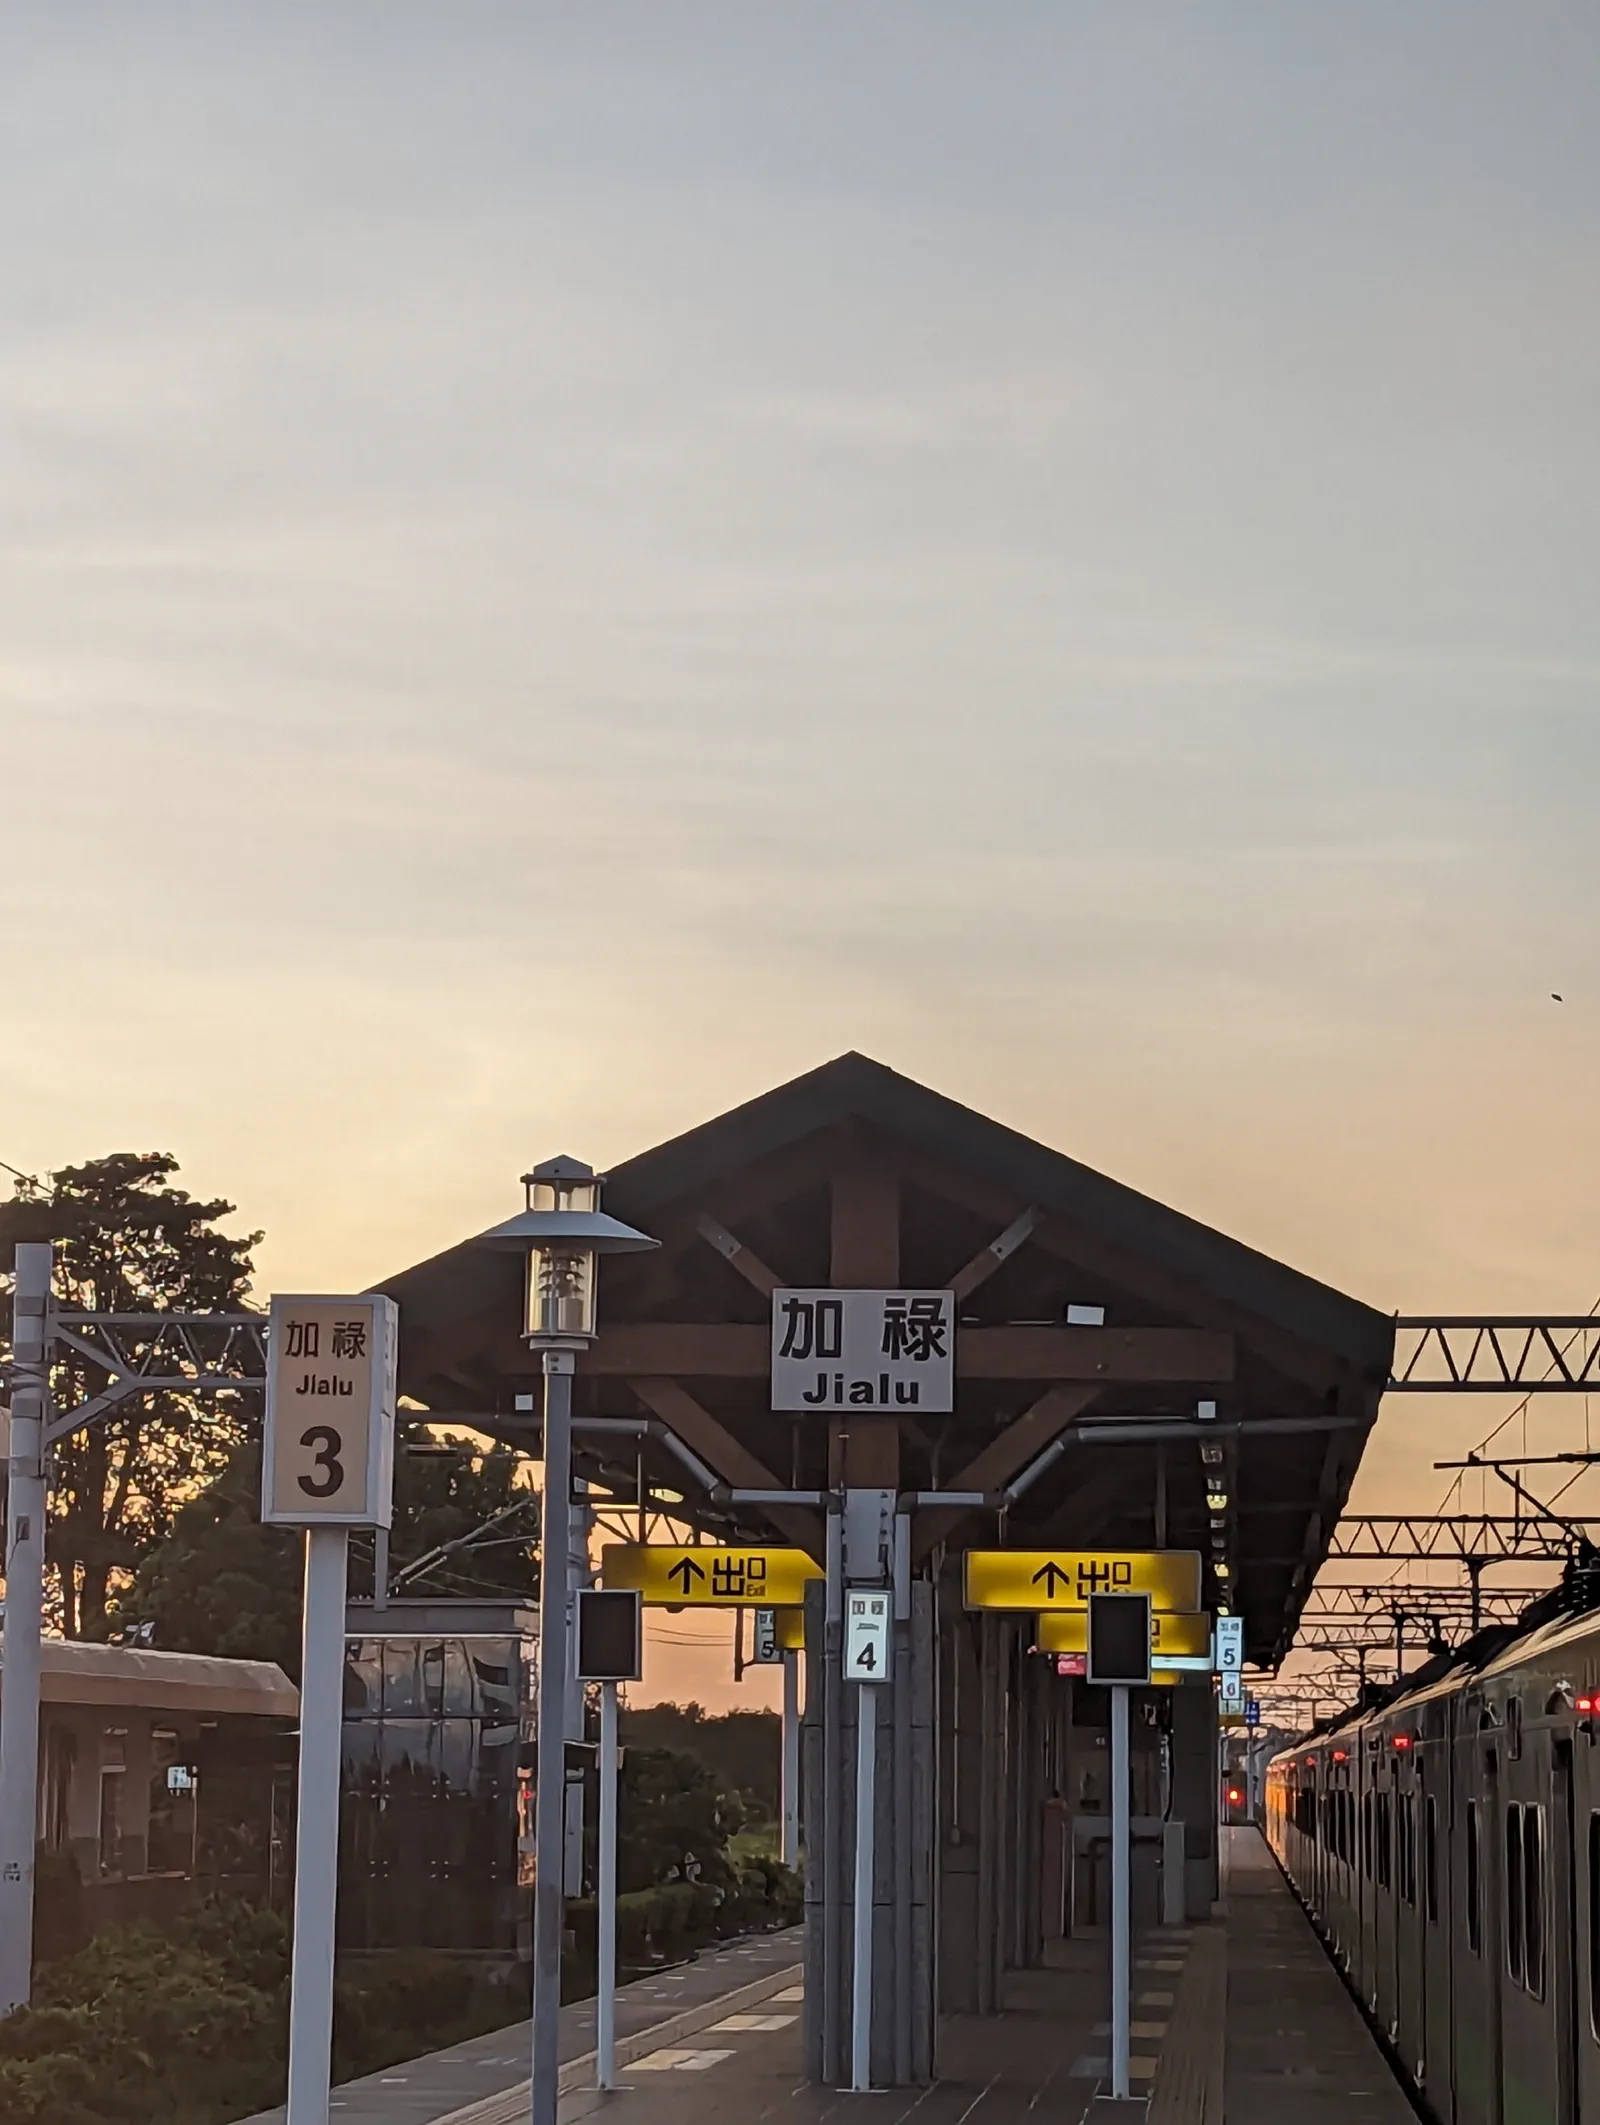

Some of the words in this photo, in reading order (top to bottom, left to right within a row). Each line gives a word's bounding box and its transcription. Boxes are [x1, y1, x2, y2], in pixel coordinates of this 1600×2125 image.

[296, 1374, 353, 1396] Jialu
[802, 1373, 920, 1405] Jialu
[297, 1425, 345, 1498] 3
[712, 1556, 766, 1596] 出口
[1077, 1560, 1132, 1600] 出口
[761, 1640, 775, 1658] 5
[856, 1642, 877, 1671] 4
[1223, 1648, 1236, 1666] 5
